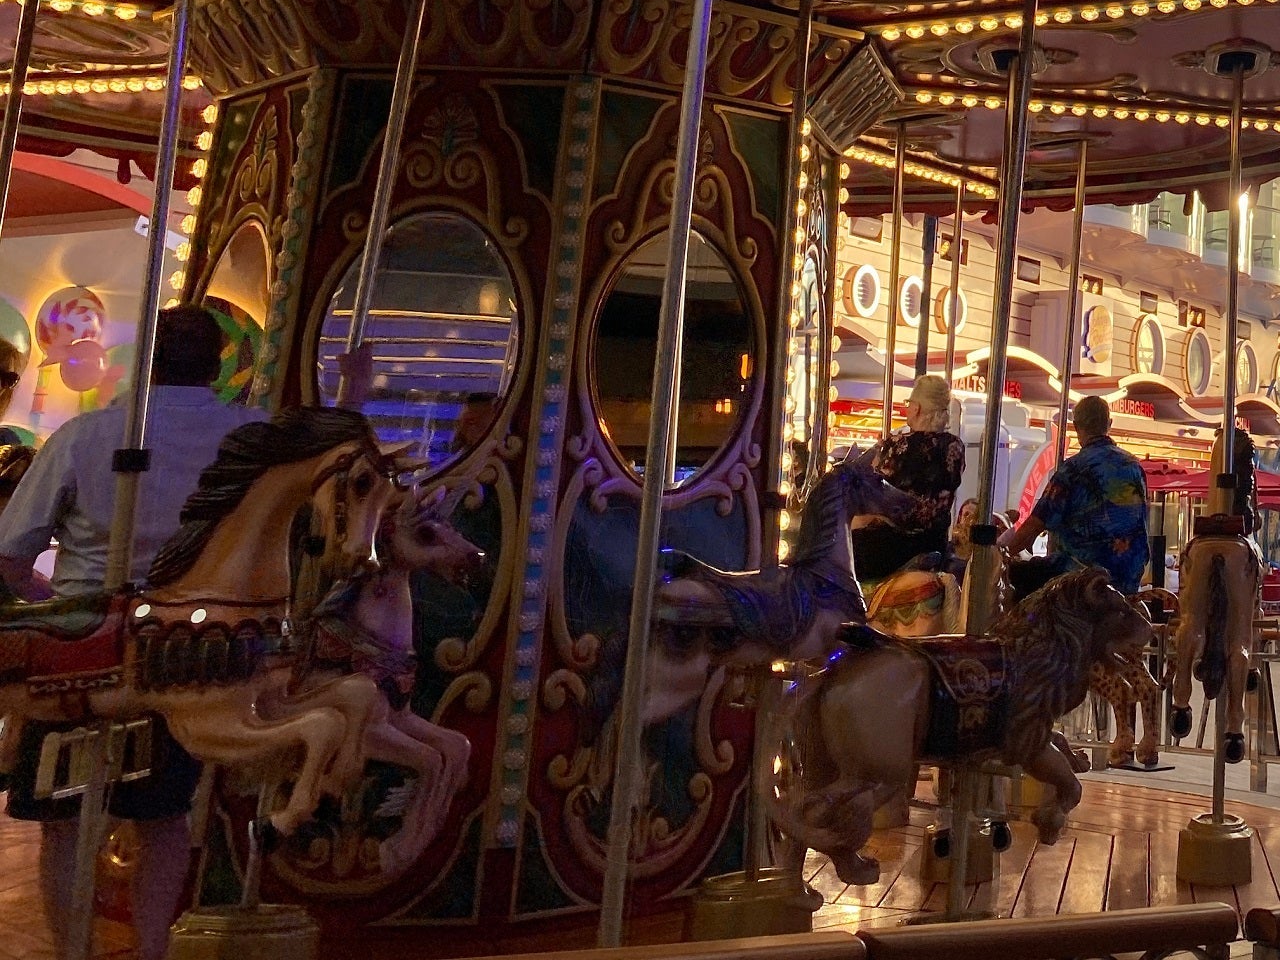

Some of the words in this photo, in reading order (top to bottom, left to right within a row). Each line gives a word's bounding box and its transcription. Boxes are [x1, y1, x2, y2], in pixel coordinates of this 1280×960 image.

[1005, 380, 1022, 398] IES
[1109, 399, 1155, 418] AMBURGERS
[1019, 458, 1046, 522] RIVE
